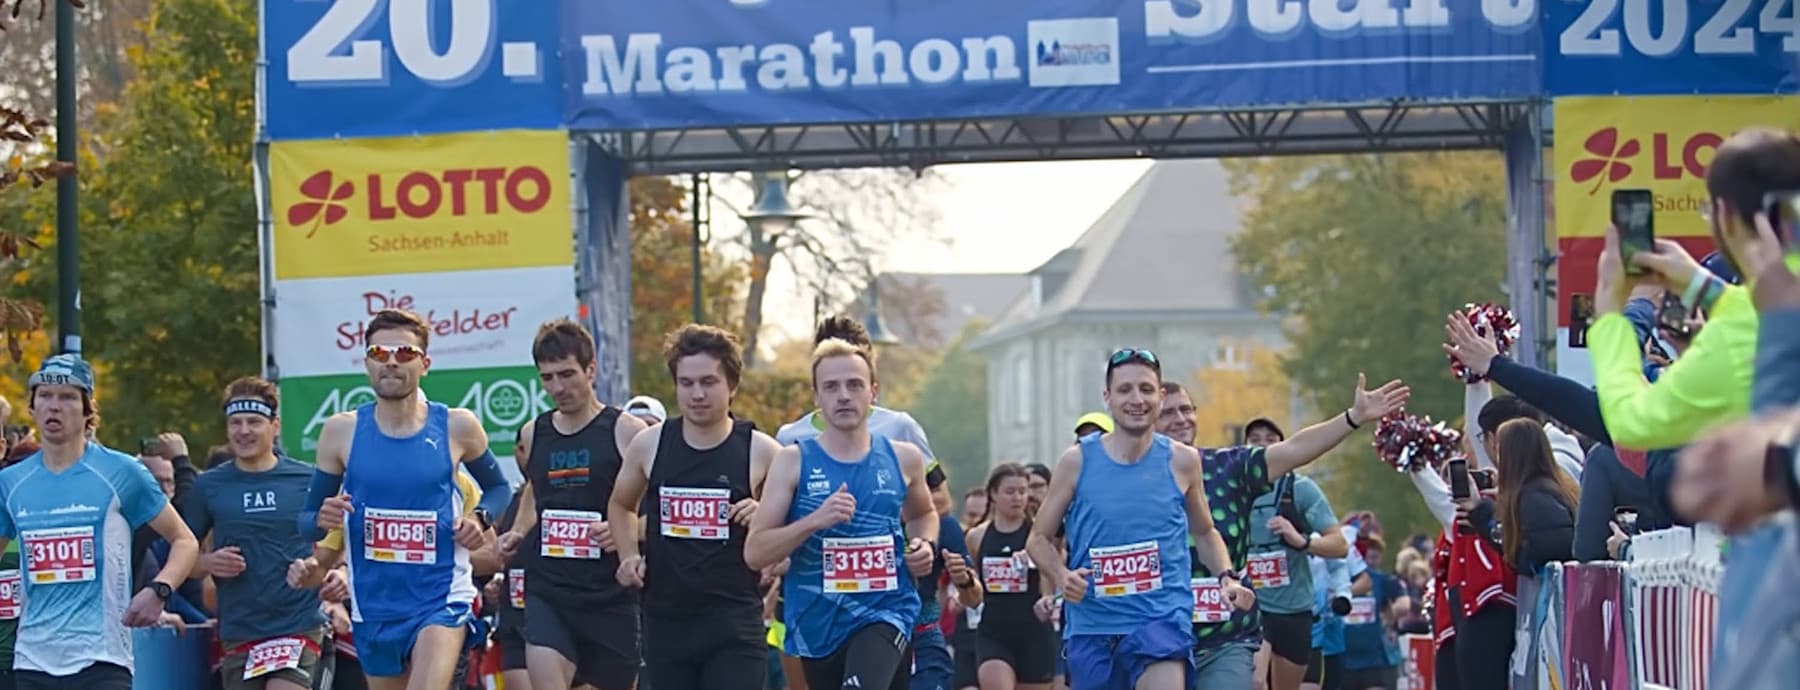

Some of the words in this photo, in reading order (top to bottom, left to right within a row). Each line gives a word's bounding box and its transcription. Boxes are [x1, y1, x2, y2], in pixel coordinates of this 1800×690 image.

[1559, 0, 1800, 56] 2024
[287, 0, 537, 81] 20.
[581, 26, 1021, 95] Marathon
[367, 165, 552, 221] LOTTO
[368, 230, 510, 253] Sachsen-Anhalt
[362, 288, 415, 316] Die
[551, 449, 590, 470] 1983
[243, 490, 277, 508] FAR
[671, 499, 715, 518] 1081
[375, 521, 424, 543] 1058
[549, 521, 590, 539] 4287
[34, 540, 79, 562] 3101
[836, 549, 886, 571] 3133
[1103, 554, 1150, 577] 4202
[1251, 561, 1276, 575] 392
[250, 645, 292, 664] 3333
